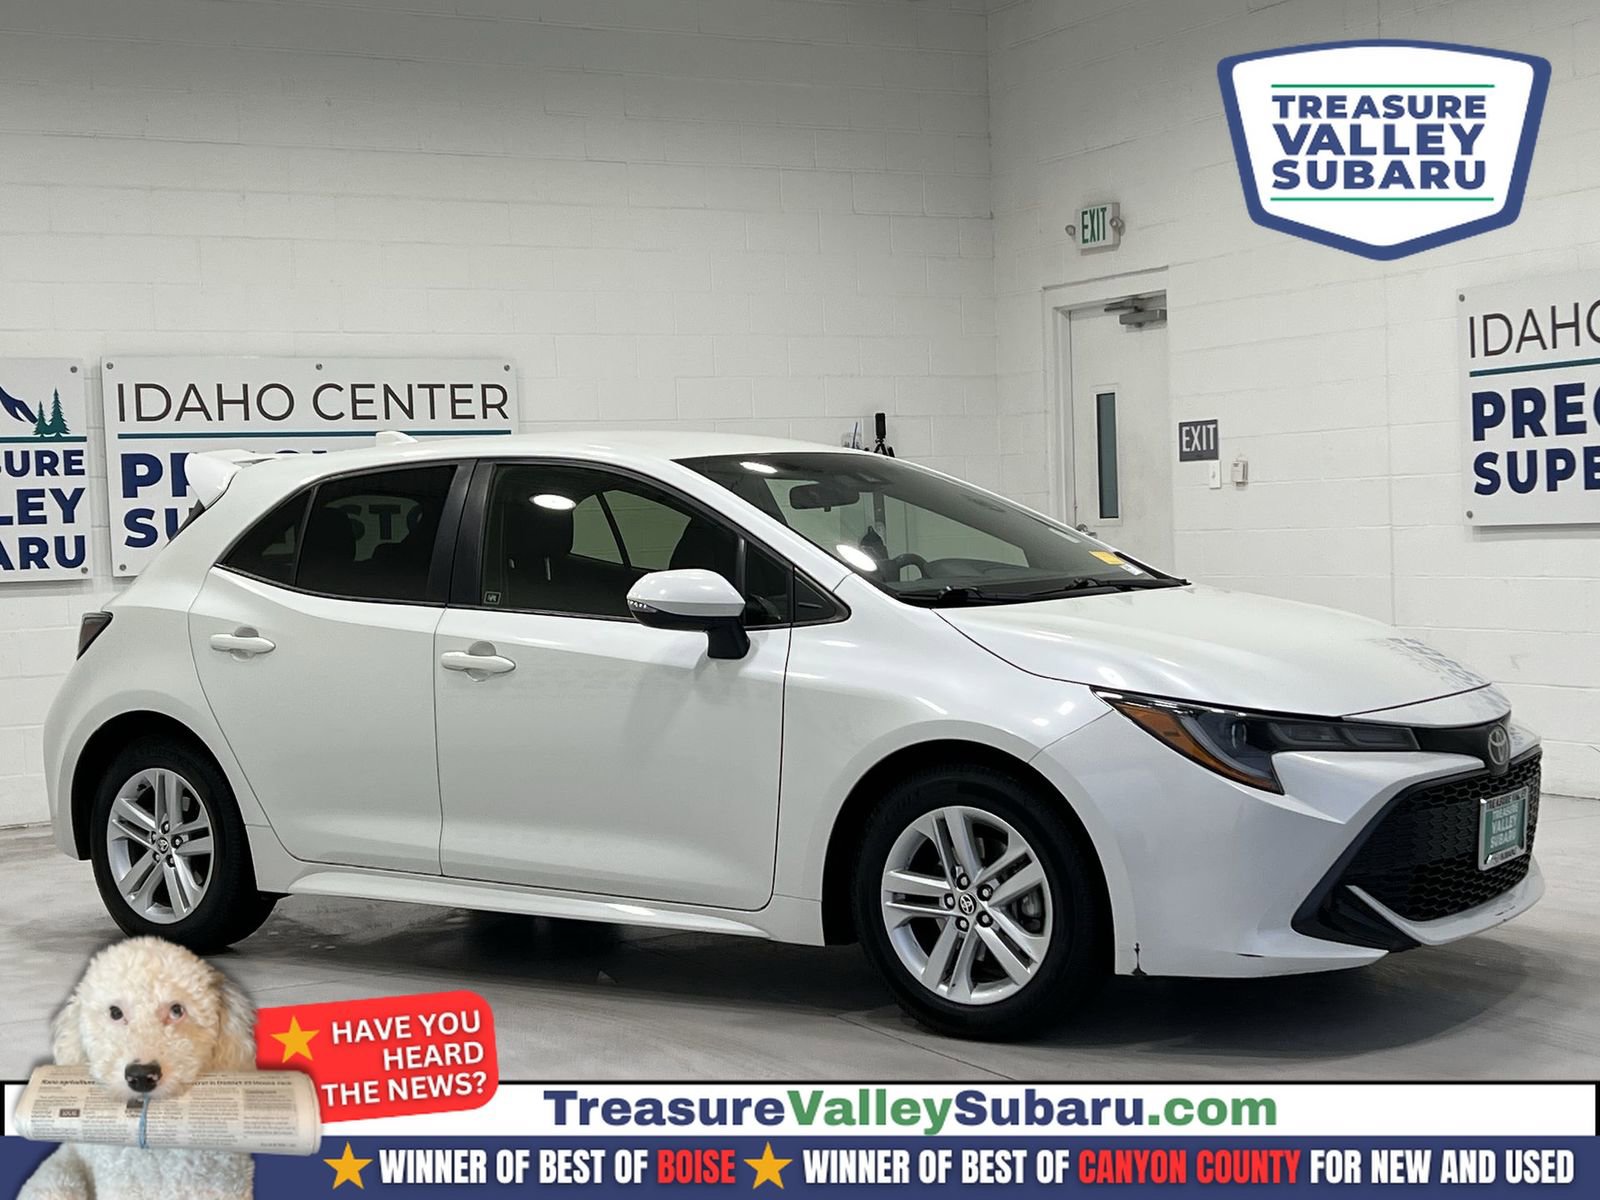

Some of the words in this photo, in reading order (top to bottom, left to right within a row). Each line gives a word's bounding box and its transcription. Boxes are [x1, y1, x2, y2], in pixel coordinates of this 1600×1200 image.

[1081, 207, 1107, 244] EXIT
[117, 383, 295, 422] IDAHO
[312, 383, 509, 421] CENTER
[1472, 381, 1600, 442] PRE
[1181, 424, 1217, 452] EXIT
[0, 450, 86, 477] URE
